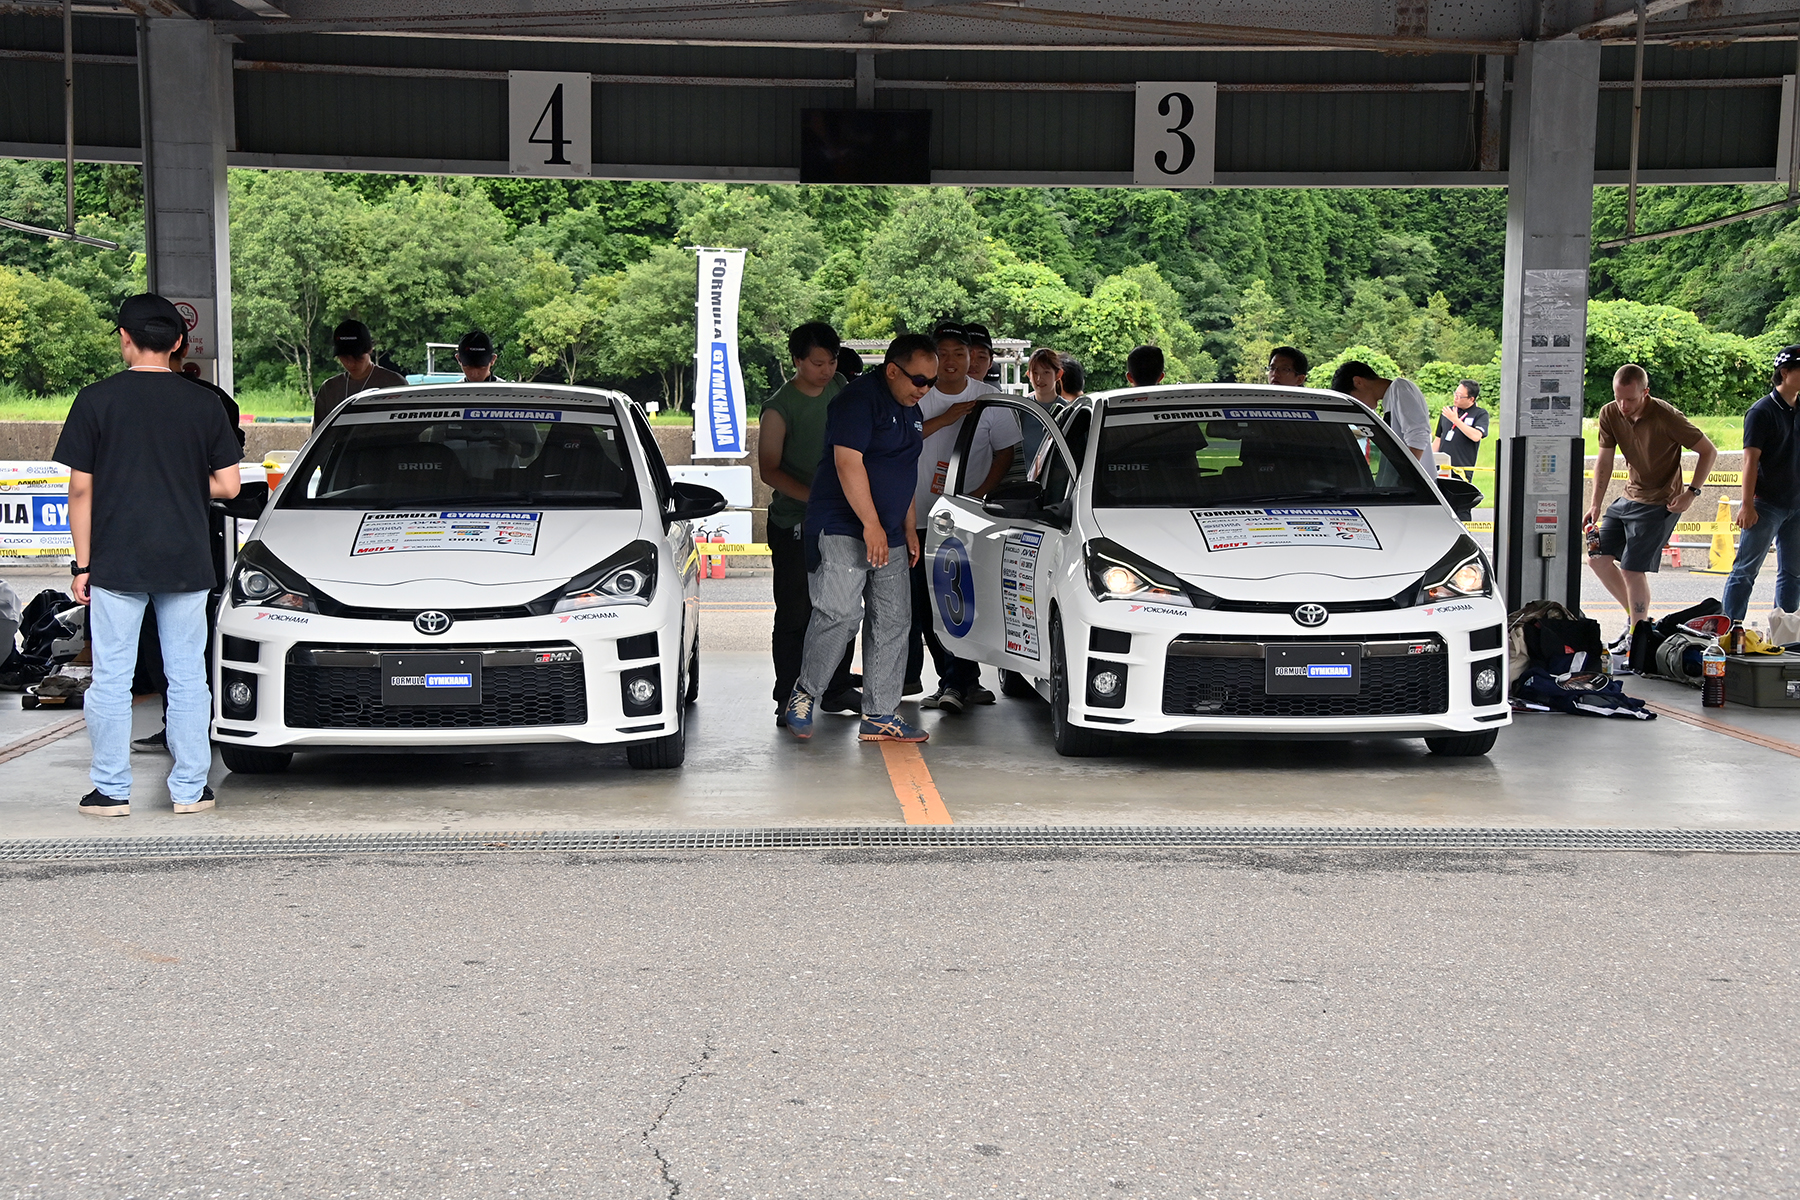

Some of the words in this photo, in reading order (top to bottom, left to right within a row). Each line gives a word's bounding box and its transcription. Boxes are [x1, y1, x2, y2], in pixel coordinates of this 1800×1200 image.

[528, 83, 572, 165] 4
[1154, 92, 1195, 175] 3
[711, 257, 727, 339] FORMULA
[712, 349, 735, 446] GYMKHANA
[389, 410, 461, 420] FORMULA
[470, 410, 555, 420] GYMKHANA
[1153, 410, 1223, 421] FORMULA
[1229, 410, 1313, 419] GYMKHANA
[398, 462, 443, 470] BRIDE
[1108, 463, 1149, 471] BRIDE
[1708, 473, 1739, 483] CUIDADO
[366, 512, 438, 520] FORMULA
[1196, 509, 1264, 517] FORMULA
[1464, 522, 1492, 530] CUIDADO
[357, 545, 395, 553] Moty's
[718, 544, 745, 552] CAUTION
[943, 547, 966, 627] 3
[1143, 606, 1188, 616] YOKOHAMA
[1435, 603, 1474, 613] YOKOHAMA
[267, 613, 309, 624] YOKOHAMA
[572, 612, 619, 621] YOKOHAMA
[1275, 667, 1307, 676] FORMULA
[1310, 667, 1349, 676] GYMKHANA
[391, 676, 425, 686] FORMULA
[428, 676, 469, 686] GYMKHANA
